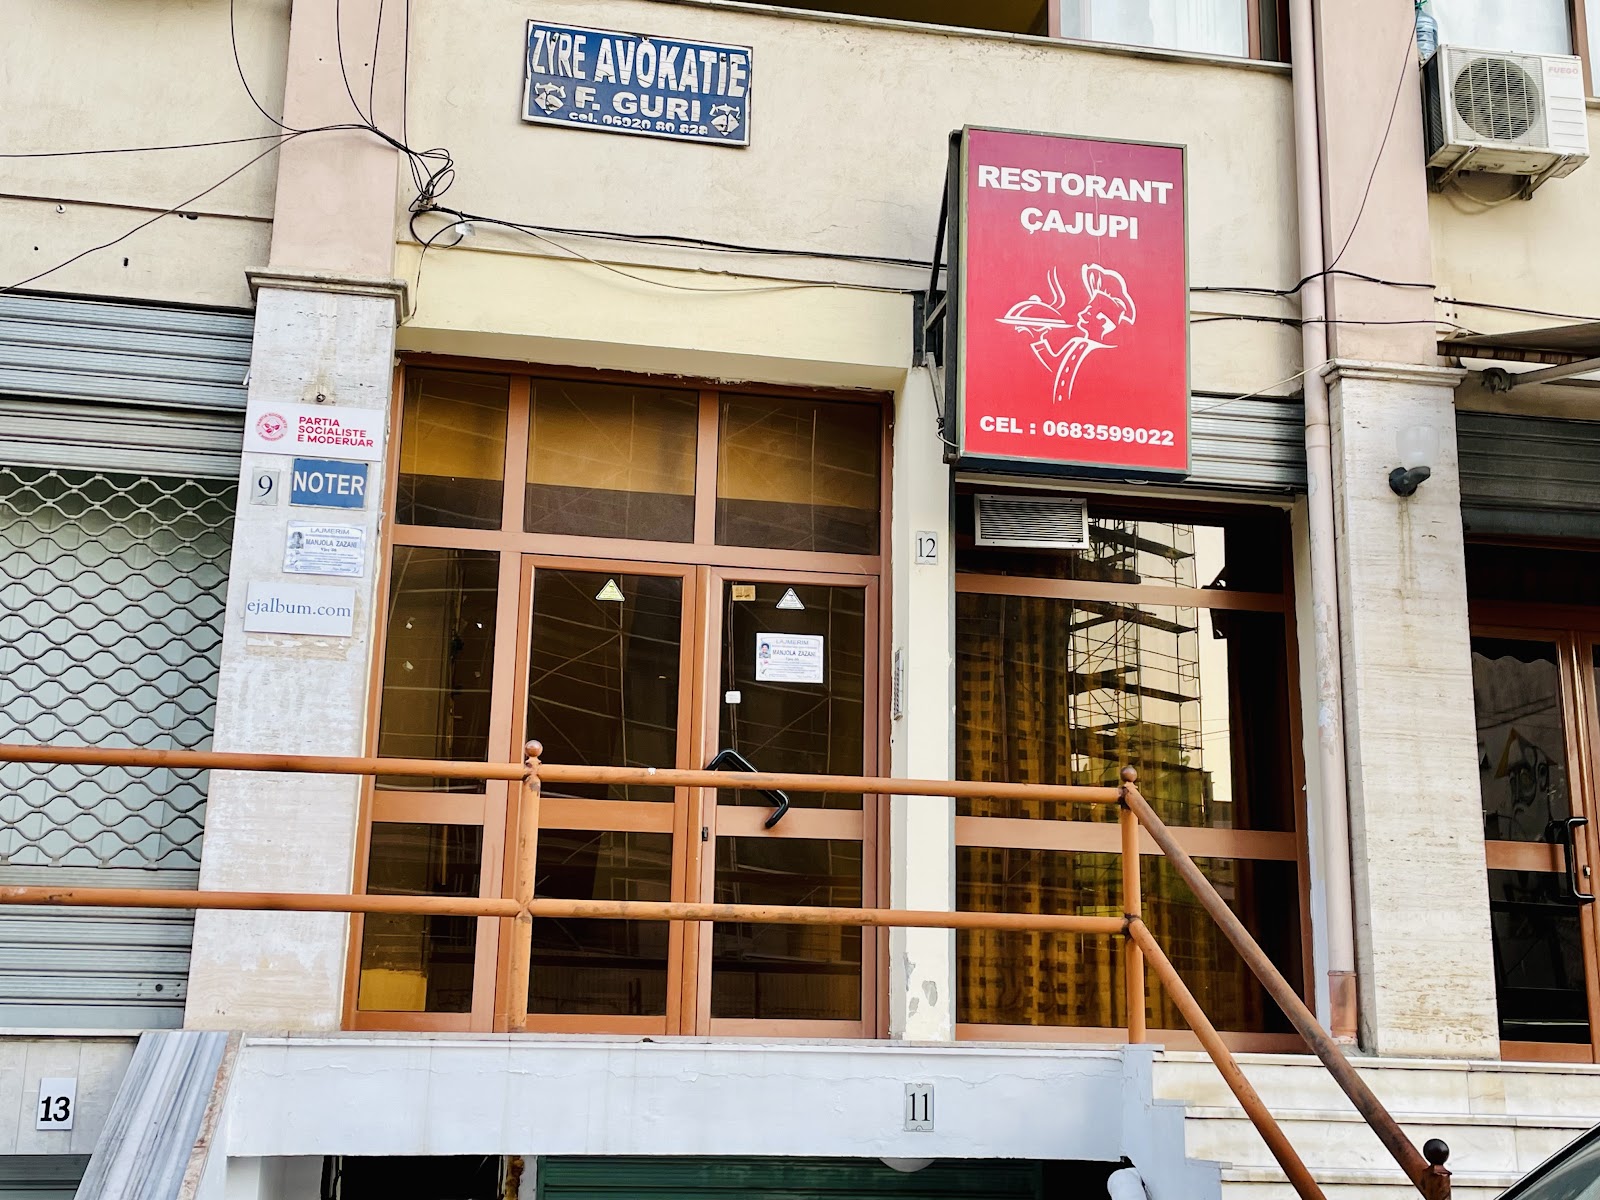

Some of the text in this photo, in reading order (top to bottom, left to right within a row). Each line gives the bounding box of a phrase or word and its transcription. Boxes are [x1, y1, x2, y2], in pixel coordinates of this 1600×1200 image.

[531, 29, 748, 98] ZYRE AVOKATIE
[574, 86, 701, 122] F. GURI
[977, 164, 1174, 205] RESTORANT
[1020, 207, 1139, 240] ÇAJUPI
[297, 425, 367, 438] SOCIALISTE
[298, 416, 340, 427] PARTIA
[979, 415, 1023, 434] CEL
[1043, 420, 1175, 447] 0683599022
[297, 434, 374, 447] E MODERUAR
[257, 474, 273, 498] 9
[293, 470, 365, 496] NOTER
[917, 537, 936, 558] 12
[246, 597, 351, 618] ejalbum.com
[40, 1096, 71, 1122] 13
[909, 1092, 931, 1122] 11
